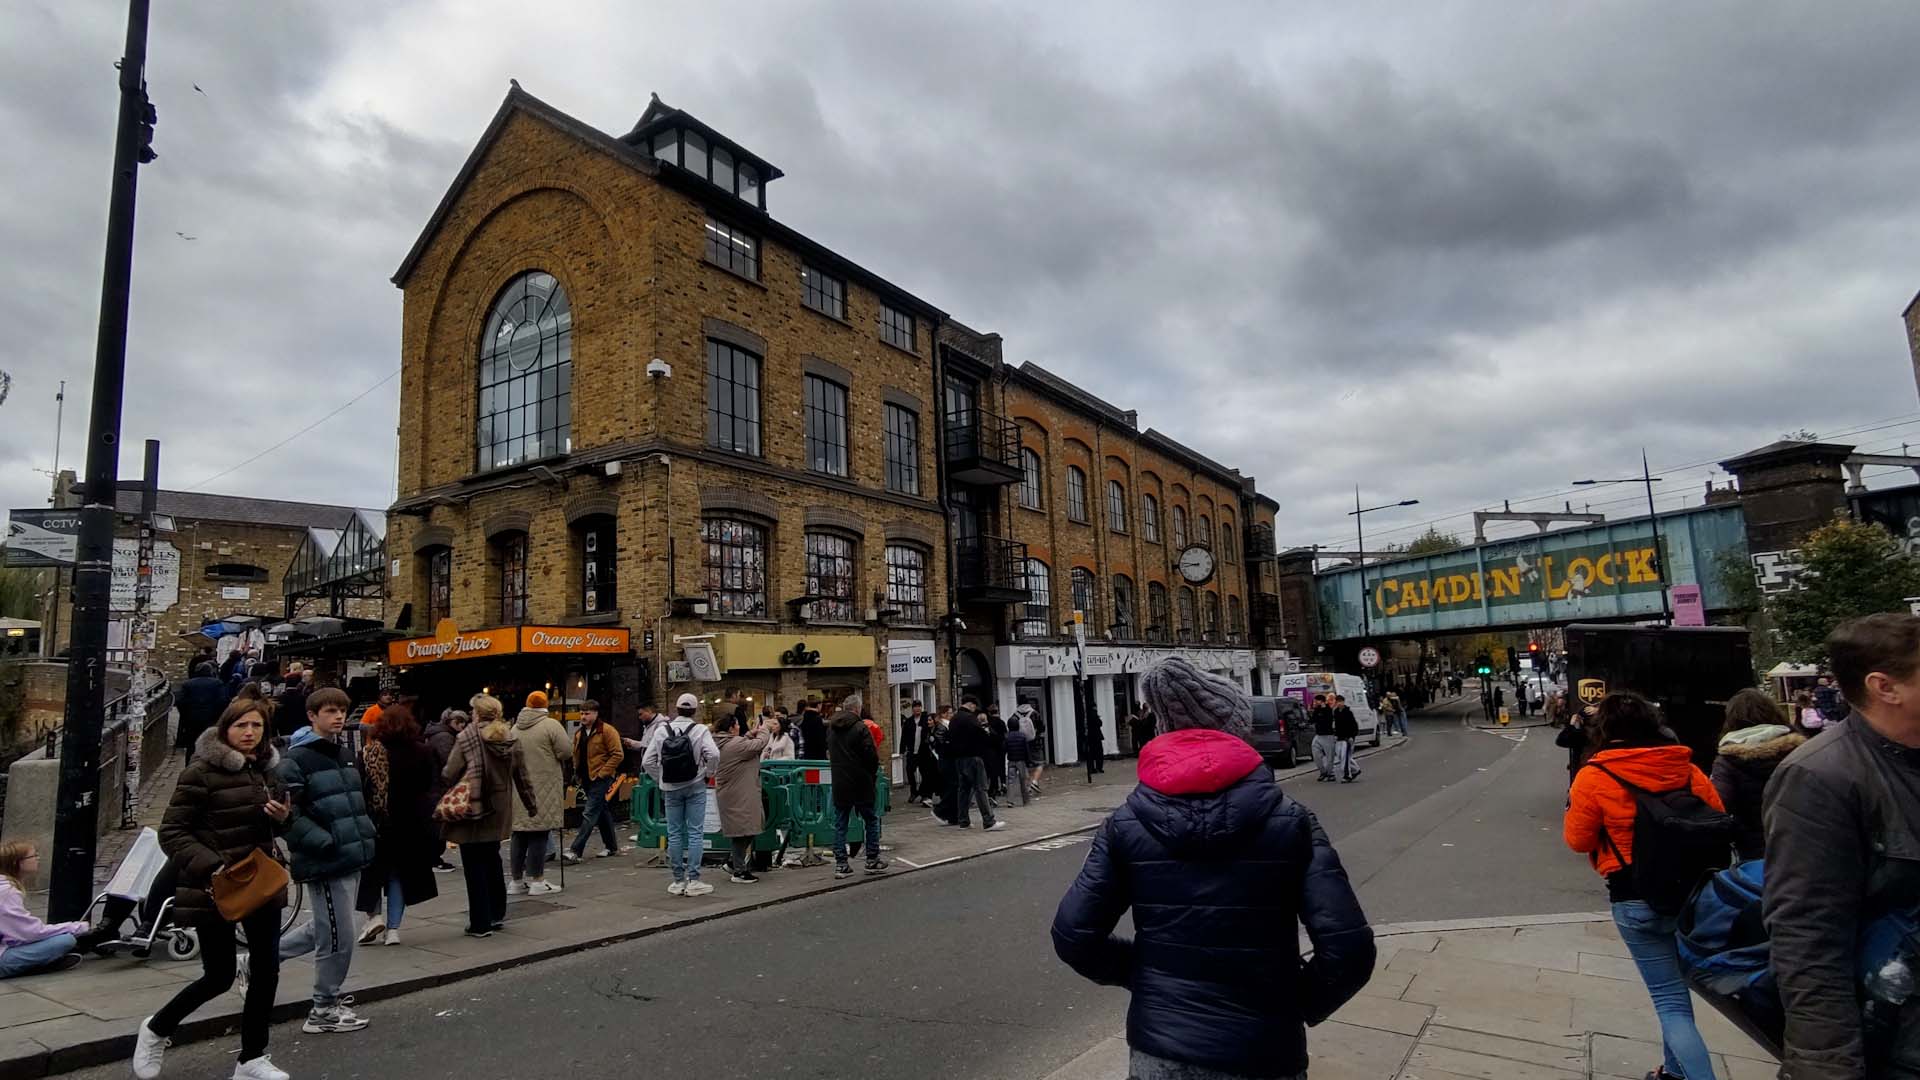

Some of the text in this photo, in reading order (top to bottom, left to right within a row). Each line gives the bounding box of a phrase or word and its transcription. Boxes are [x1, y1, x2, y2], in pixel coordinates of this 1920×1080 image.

[42, 519, 77, 529] CCTV
[1375, 547, 1659, 616] CAMDEN LOCK
[406, 635, 492, 660] Orange Juice
[532, 630, 621, 649] Orange Juice
[912, 656, 932, 664] SOCKS
[1580, 687, 1604, 702] ups
